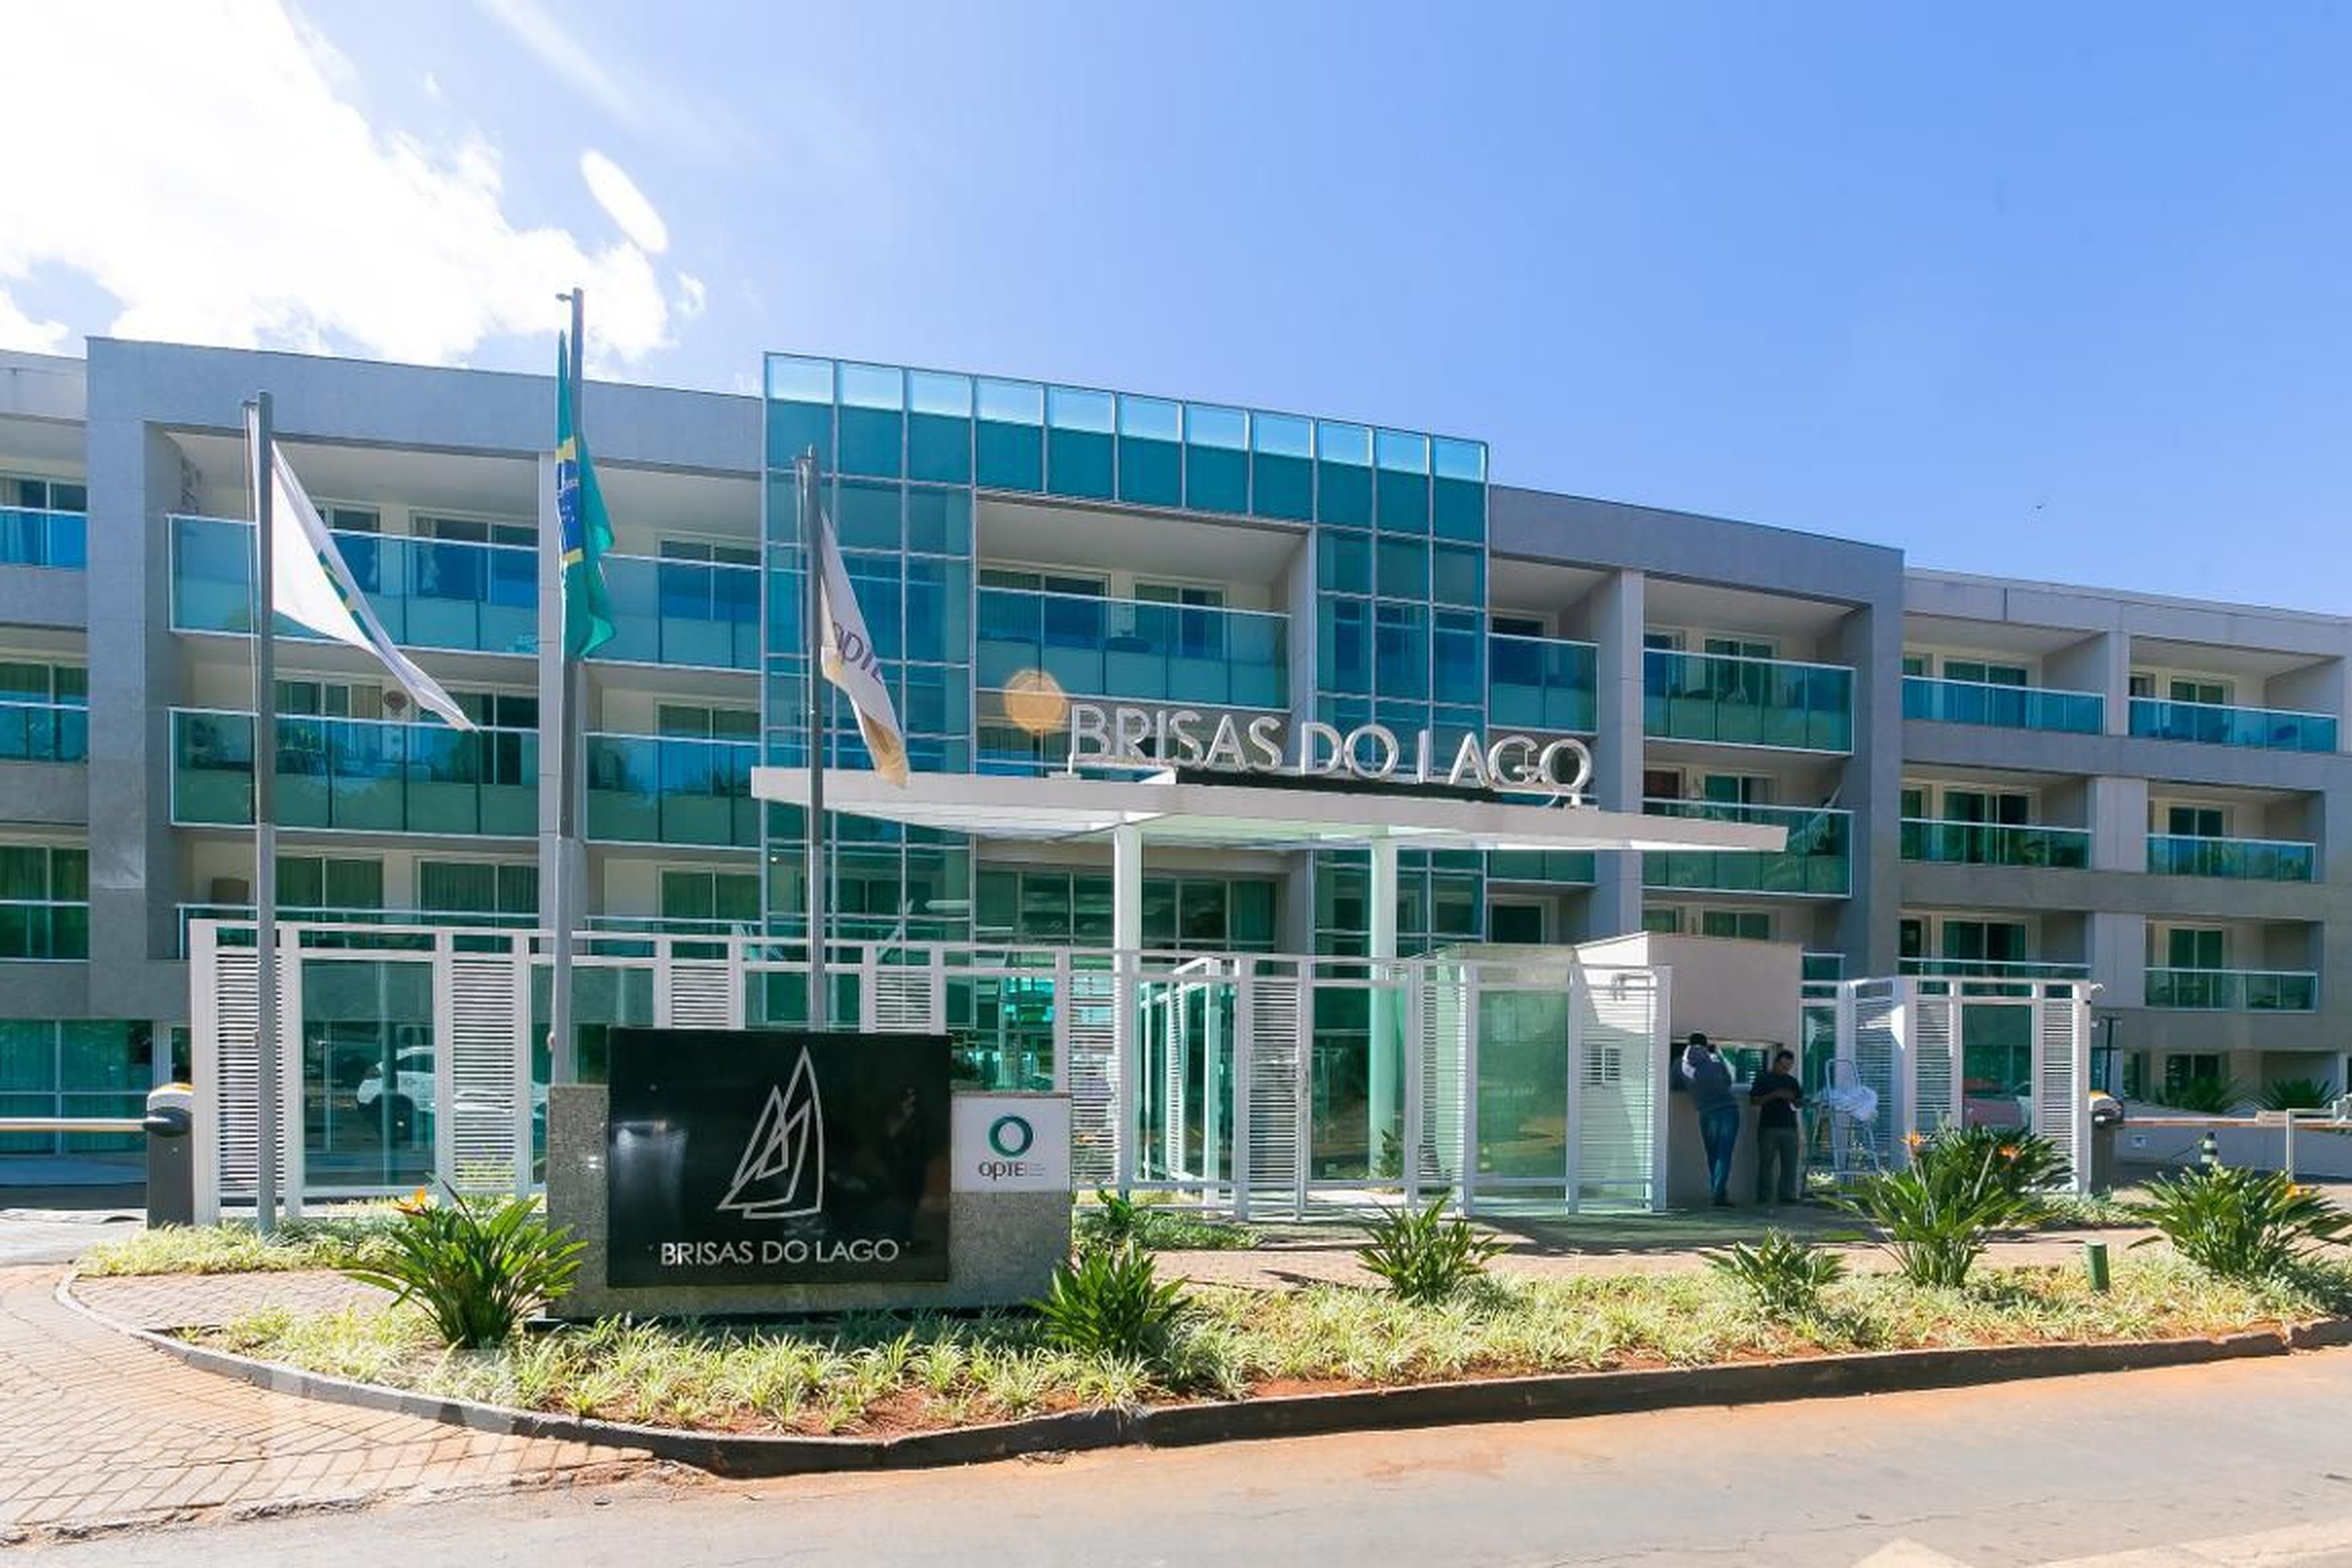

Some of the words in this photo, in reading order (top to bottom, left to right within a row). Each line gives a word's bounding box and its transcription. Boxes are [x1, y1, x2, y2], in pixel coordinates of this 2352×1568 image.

[1070, 703, 1283, 772] BRISAS
[1300, 721, 1400, 778] DO
[1417, 729, 1593, 790] LAGO
[661, 1240, 754, 1266] BRISAS
[763, 1239, 809, 1264] DO
[816, 1238, 900, 1262] LAGO
